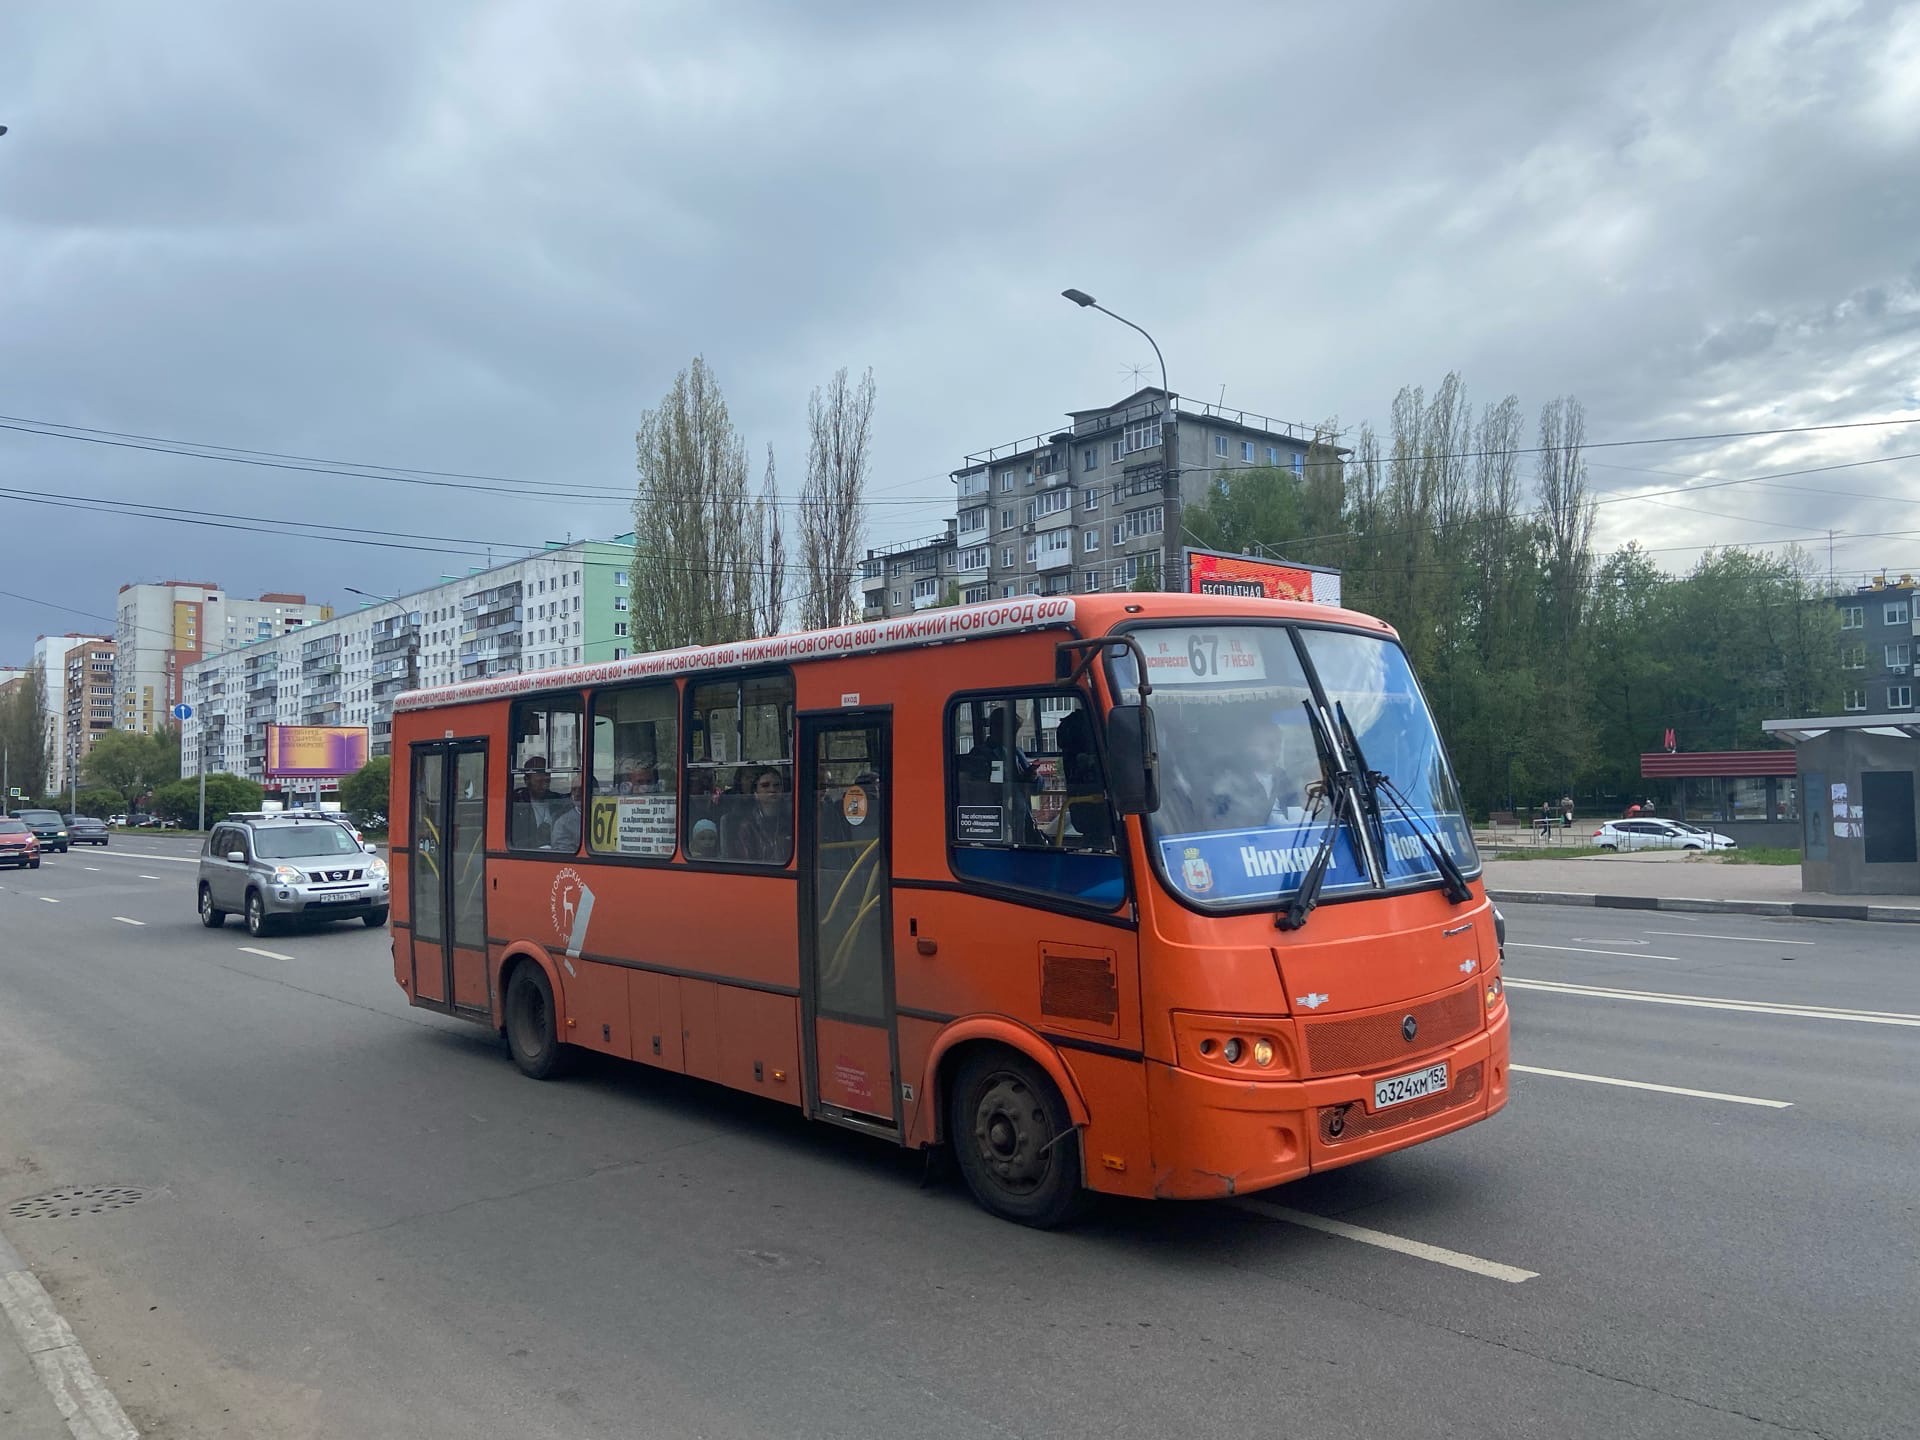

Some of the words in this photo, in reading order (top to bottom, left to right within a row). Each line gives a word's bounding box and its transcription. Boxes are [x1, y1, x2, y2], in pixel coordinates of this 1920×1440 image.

[486, 680, 518, 695] НОВГОРОД
[519, 678, 530, 690] 800
[535, 673, 566, 689] НИЖНИЙ
[567, 669, 607, 686] НОВГОРОД
[608, 666, 621, 679] 800
[628, 660, 665, 676] НИЖНИЙ
[667, 652, 716, 670] НОВГОРОД
[717, 649, 734, 664] 800
[742, 641, 787, 662] НИЖНИЙ
[790, 633, 852, 653] НОВГОРОД
[855, 629, 876, 645] 800
[886, 616, 946, 641] НИЖНИЙ
[950, 604, 1033, 632] НОВГОРОД
[1037, 601, 1068, 619] 800
[1188, 634, 1219, 677] 67
[594, 803, 617, 844] 67
[1378, 1077, 1427, 1104] О324ХМ
[1429, 1067, 1445, 1085] 152
